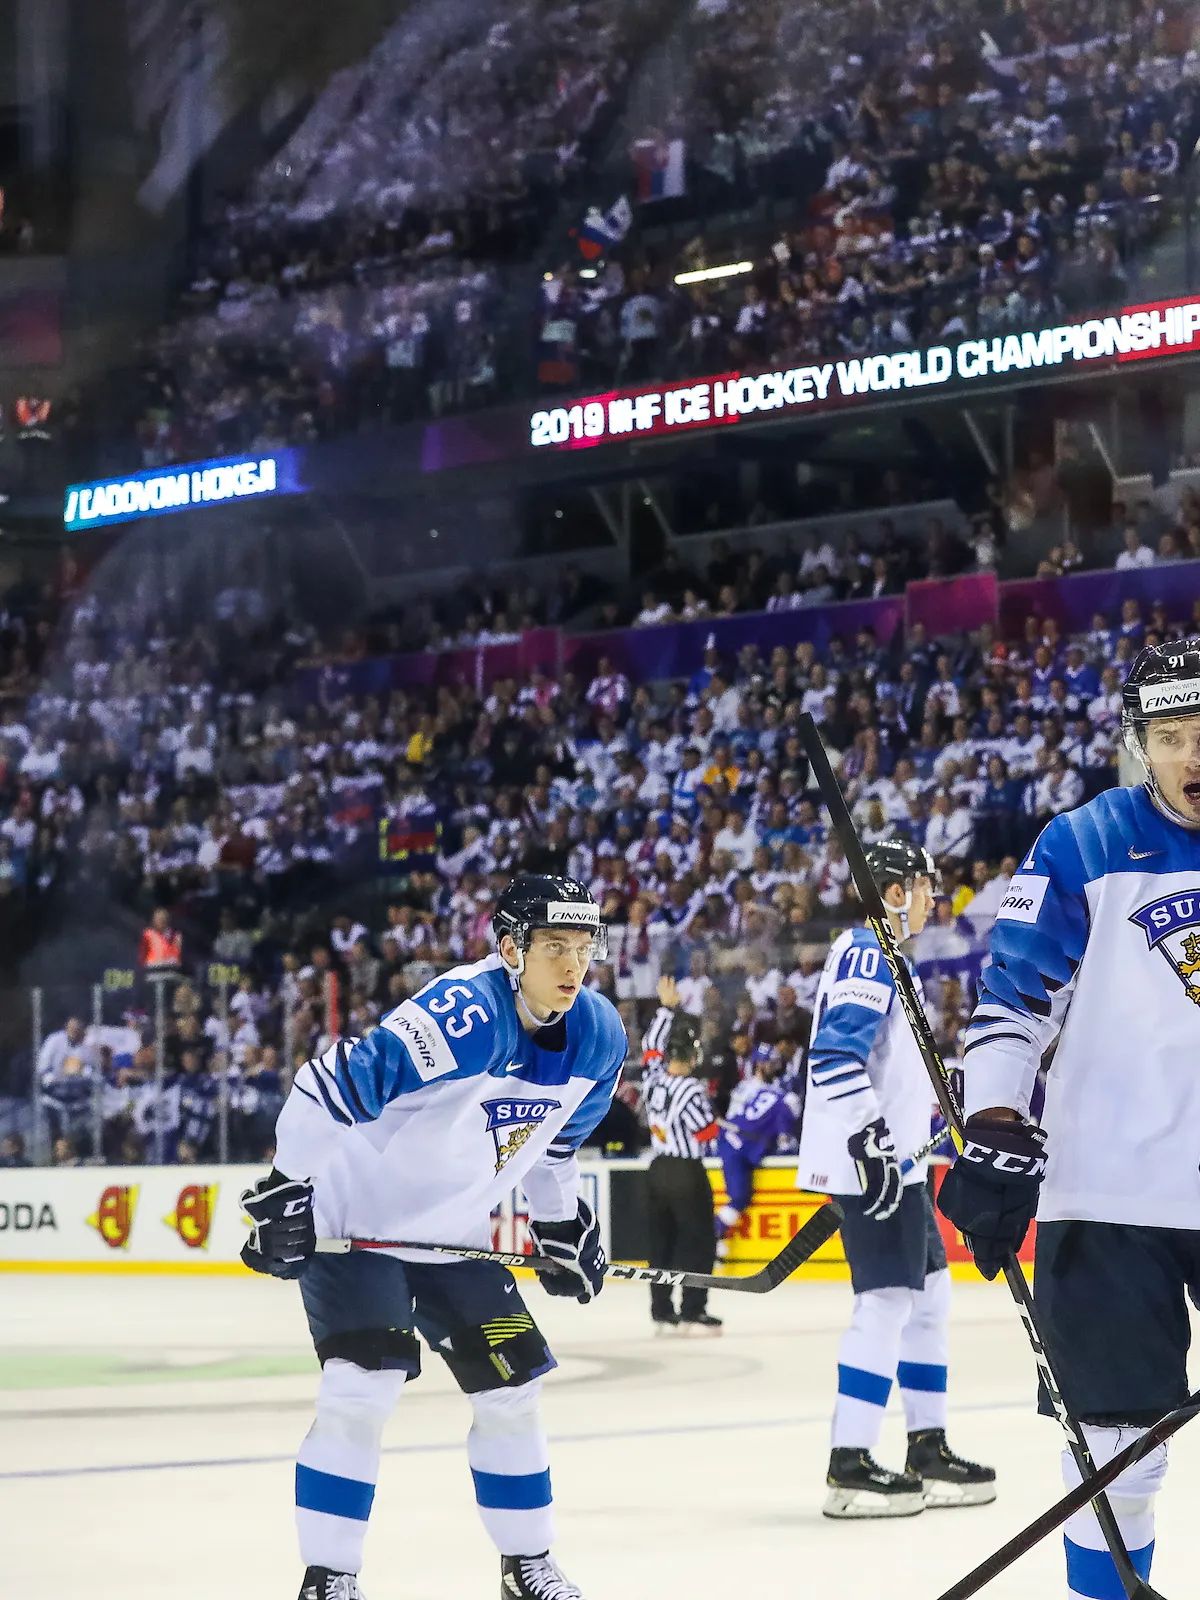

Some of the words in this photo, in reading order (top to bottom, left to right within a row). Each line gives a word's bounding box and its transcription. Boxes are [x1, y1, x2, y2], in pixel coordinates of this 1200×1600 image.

[530, 402, 602, 447] 2019
[664, 382, 710, 425] ICE
[714, 369, 836, 418] HOCKEY
[836, 346, 951, 398] WORLD
[1168, 655, 1185, 668] 91
[564, 883, 580, 893] 55
[551, 911, 599, 922] FINNAIR
[846, 946, 880, 979] 70
[428, 985, 489, 1039] 55
[392, 1016, 435, 1068] FINNAIR
[604, 1264, 686, 1286] CCM
